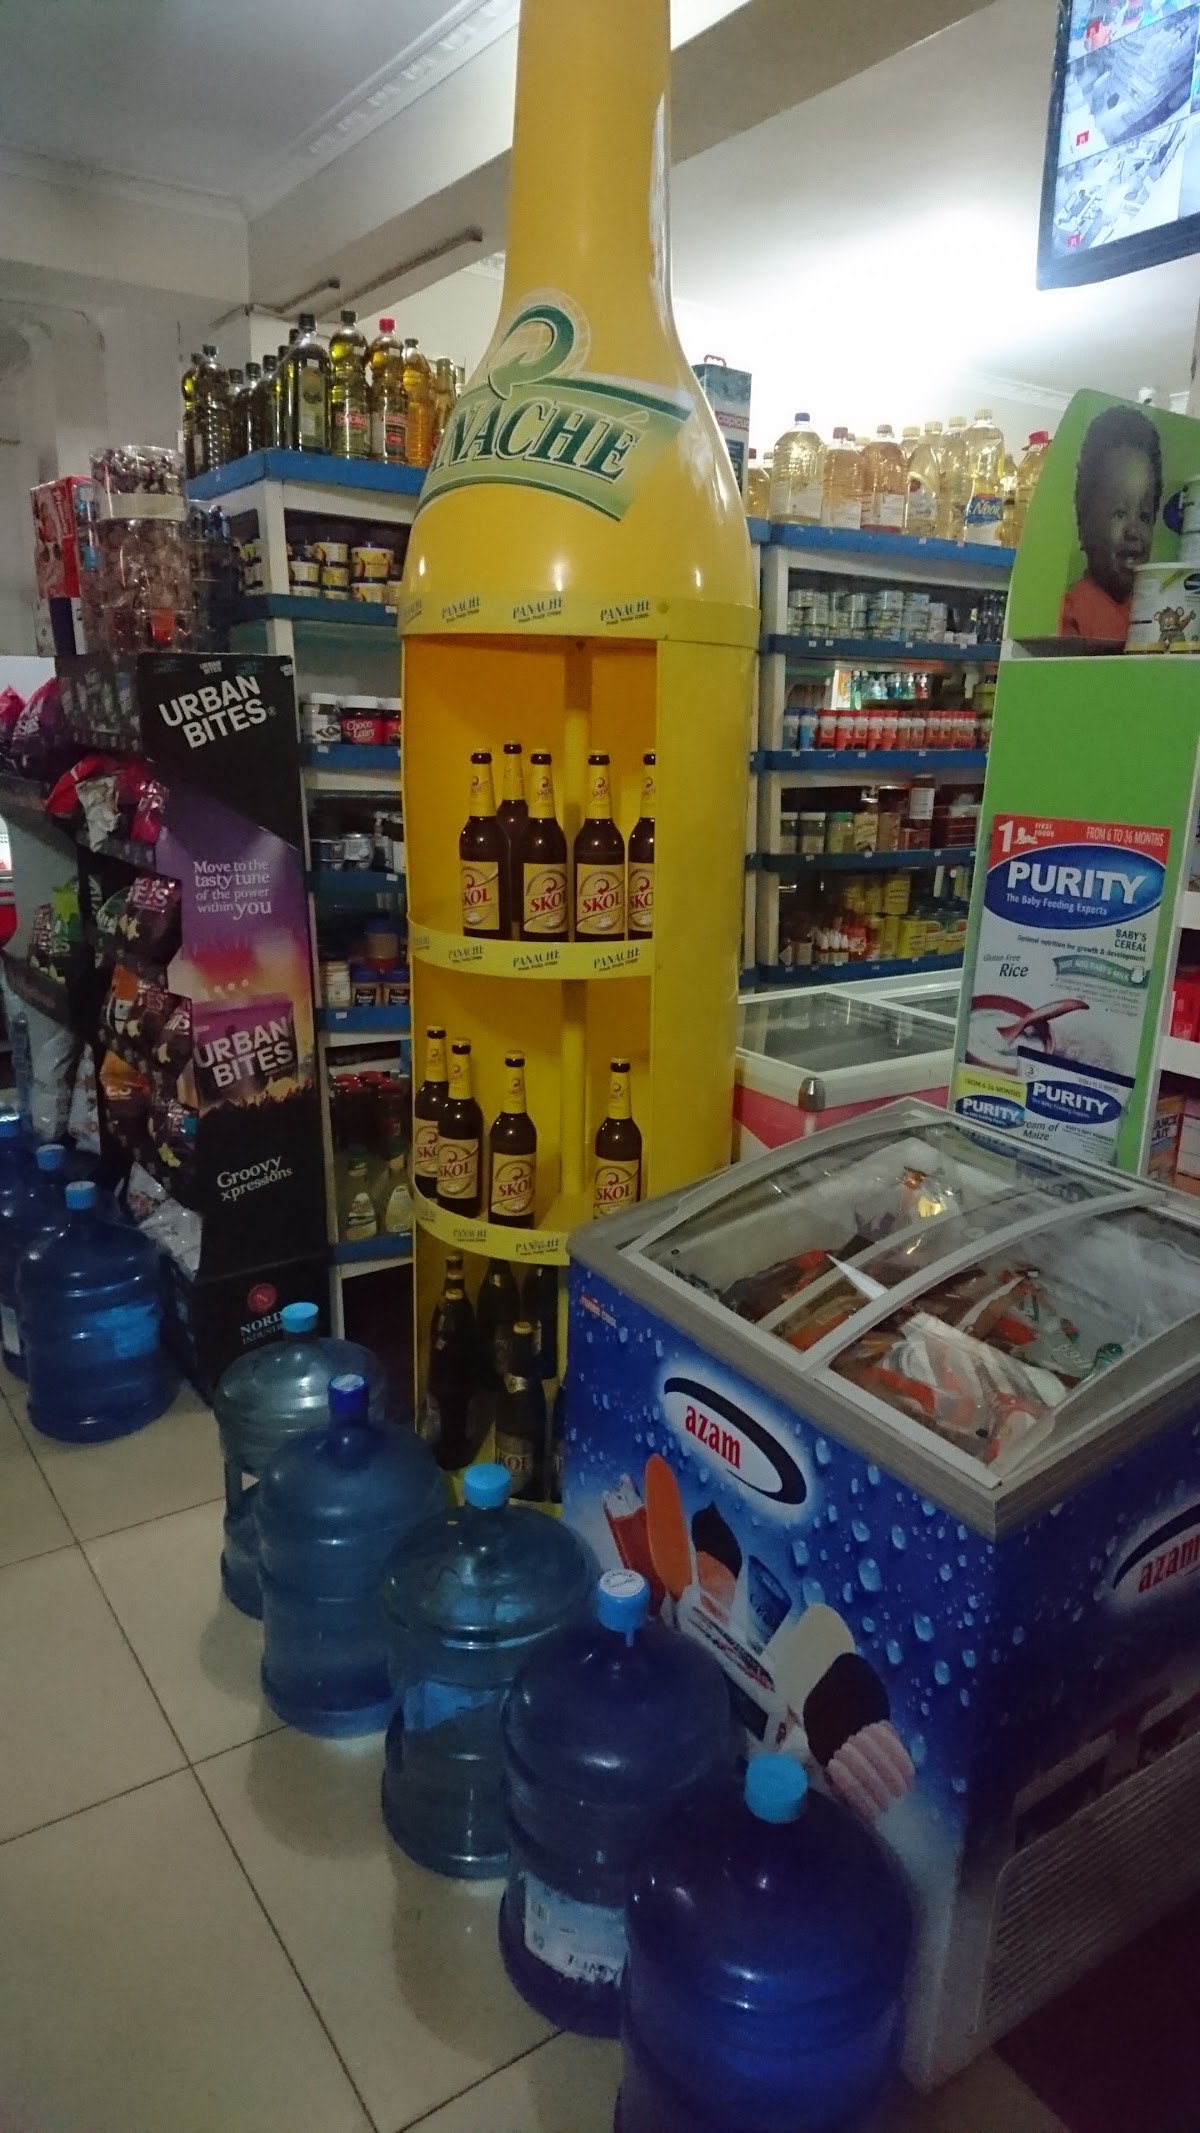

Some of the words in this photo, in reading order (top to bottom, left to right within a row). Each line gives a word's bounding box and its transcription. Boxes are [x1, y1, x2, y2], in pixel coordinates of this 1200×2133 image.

[159, 675, 261, 727] URBAN
[182, 698, 268, 749] BITES
[998, 820, 1014, 853] 1
[1086, 826, 1106, 841] FROM
[1106, 829, 1112, 841] 6
[1113, 829, 1123, 842] TO
[1123, 829, 1133, 844] 36
[1134, 830, 1164, 847] MONTHS
[193, 860, 231, 874] Move
[233, 861, 246, 872] to
[248, 859, 269, 871] the
[195, 874, 233, 890] tasty
[235, 872, 271, 886] tune
[1007, 860, 1147, 905] PURITY
[195, 889, 209, 901] of
[212, 888, 231, 900] the
[233, 888, 270, 903] power
[464, 888, 491, 907] KOL
[629, 890, 654, 912] SKO
[1006, 893, 1019, 904] The
[1022, 895, 1041, 908] Baby
[1043, 898, 1075, 913] Feeding
[1076, 902, 1108, 916] Experts
[197, 902, 234, 914] within
[233, 901, 272, 921] you
[1115, 928, 1147, 941] BABY'S
[1040, 939, 1066, 948] nutrition
[1076, 945, 1099, 954] growth
[1106, 949, 1146, 962] development
[1114, 939, 1147, 952] CEREAL
[983, 953, 1004, 962] Gluten
[1005, 954, 1021, 962] Free
[999, 963, 1029, 977] Rice
[194, 1016, 290, 1068] URBAN
[212, 1041, 294, 1088] BITES
[1027, 1067, 1034, 1075] 3
[996, 1085, 1023, 1098] MONTHS
[1032, 1082, 1109, 1116] PURITY
[962, 1097, 1020, 1122] PURITY
[1023, 1120, 1046, 1131] ream
[1048, 1122, 1060, 1132] of
[1023, 1129, 1050, 1141] Maize
[418, 1145, 439, 1159] SKO
[217, 1155, 282, 1189] Groovy
[220, 1167, 293, 1202] xpressions
[596, 1185, 633, 1200] SKOL
[684, 1404, 742, 1470] azam
